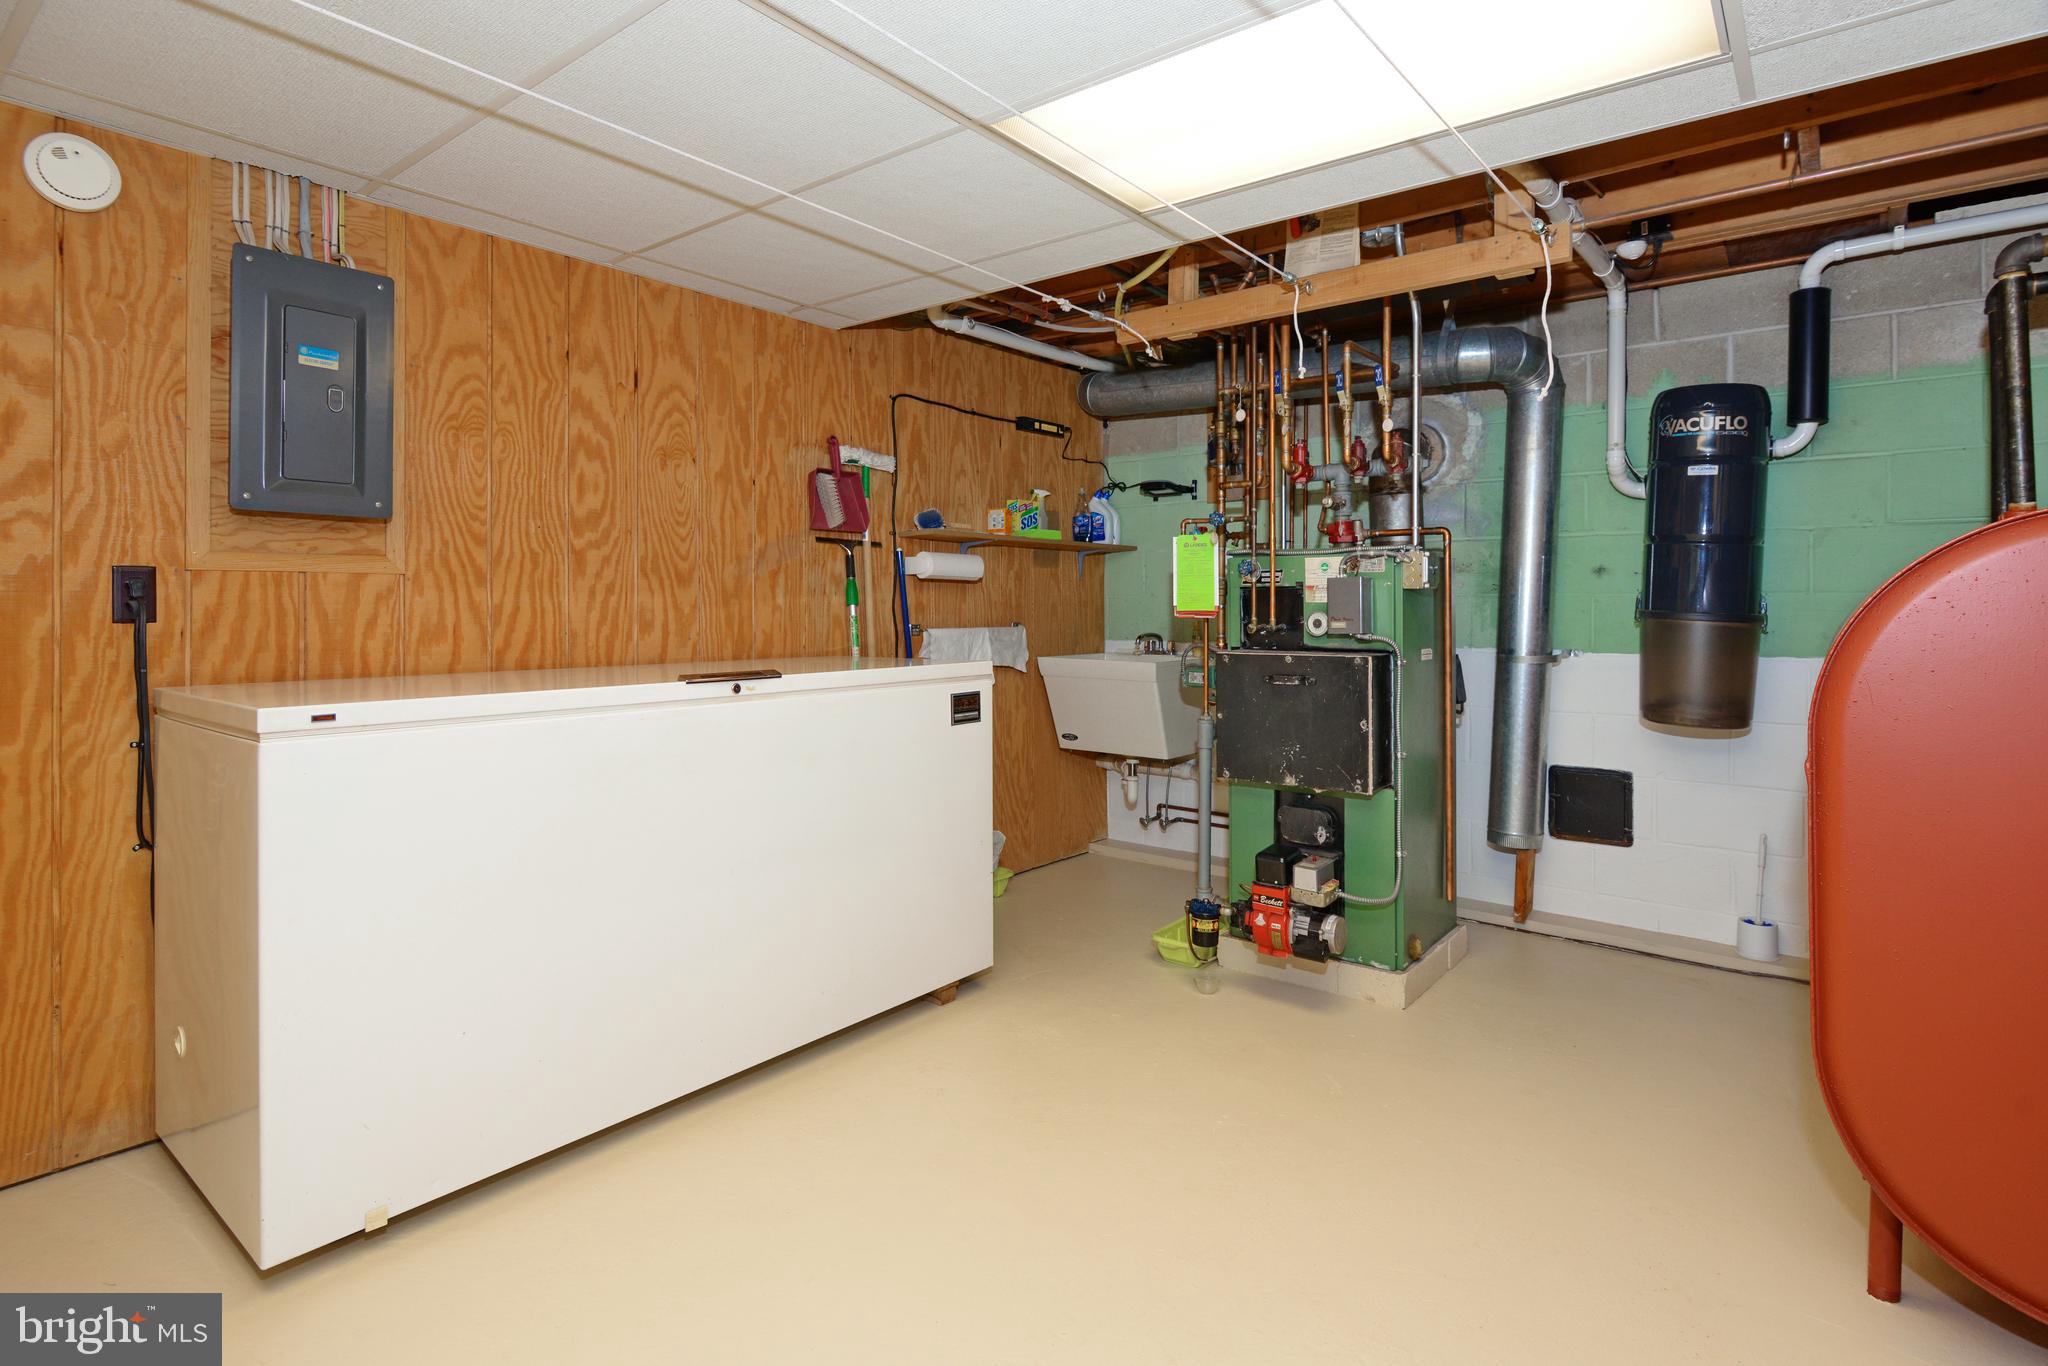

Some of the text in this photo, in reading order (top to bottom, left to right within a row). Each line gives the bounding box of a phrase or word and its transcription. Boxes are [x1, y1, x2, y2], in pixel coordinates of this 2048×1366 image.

[1666, 415, 1748, 433] VACUFLO
[1021, 512, 1038, 530] SOS
[1260, 895, 1284, 907] Beckett
